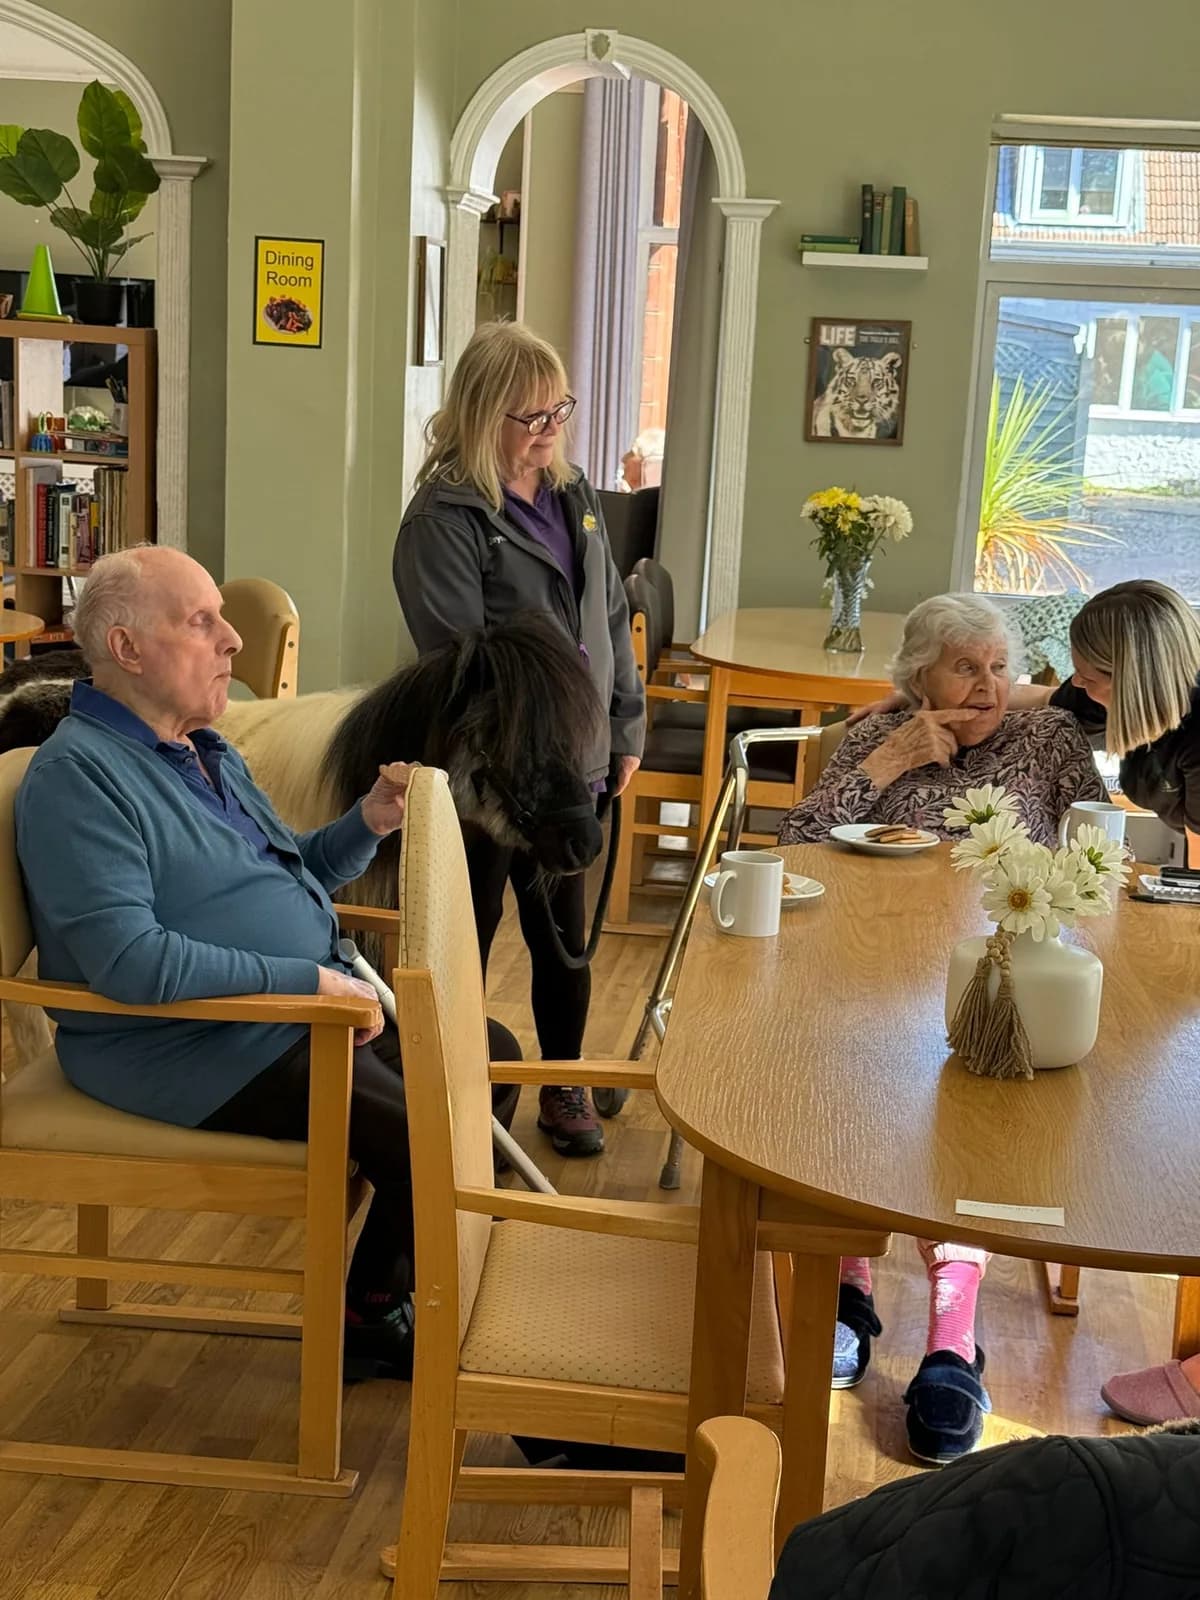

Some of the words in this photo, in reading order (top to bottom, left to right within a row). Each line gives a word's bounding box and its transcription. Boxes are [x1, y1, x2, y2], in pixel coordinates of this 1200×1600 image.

[265, 250, 314, 271] Dining
[266, 271, 312, 287] Room
[821, 325, 856, 346] LIFE
